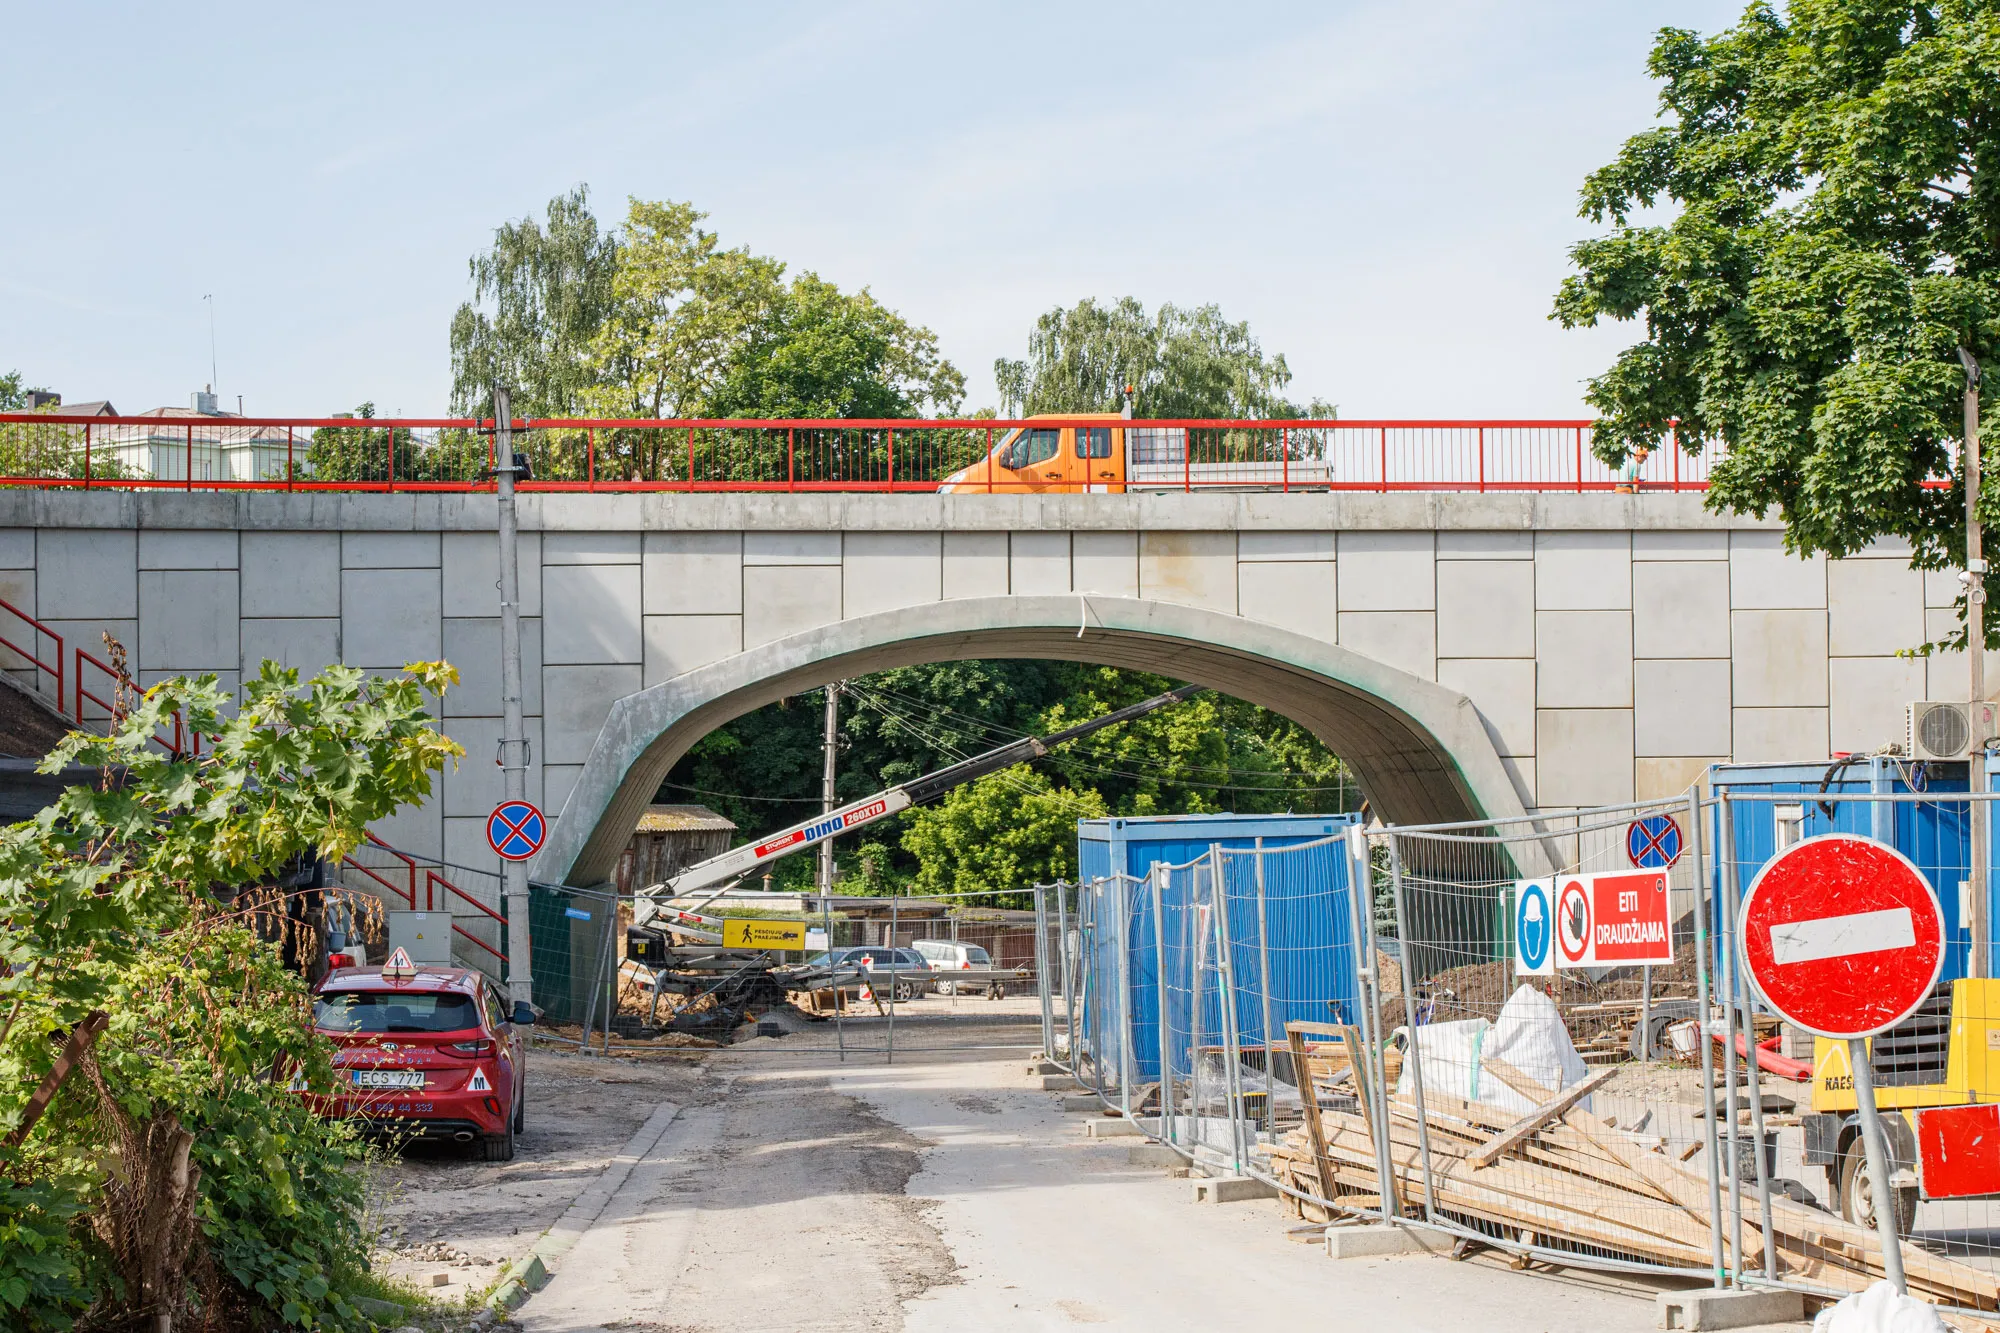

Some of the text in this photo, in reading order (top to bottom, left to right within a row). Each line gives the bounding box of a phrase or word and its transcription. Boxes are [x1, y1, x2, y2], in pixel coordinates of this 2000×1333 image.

[804, 802, 883, 842] DINO 260XTD
[765, 835, 794, 851] STORENT
[1619, 890, 1638, 912] EITI
[1596, 917, 1666, 945] DRAUDŽIAMA
[361, 1072, 389, 1084] ECS
[398, 1073, 422, 1084] 777
[474, 1077, 485, 1090] M
[1825, 1075, 1855, 1091] KAES
[398, 1103, 410, 1112] 44
[415, 1103, 433, 1112] 332
